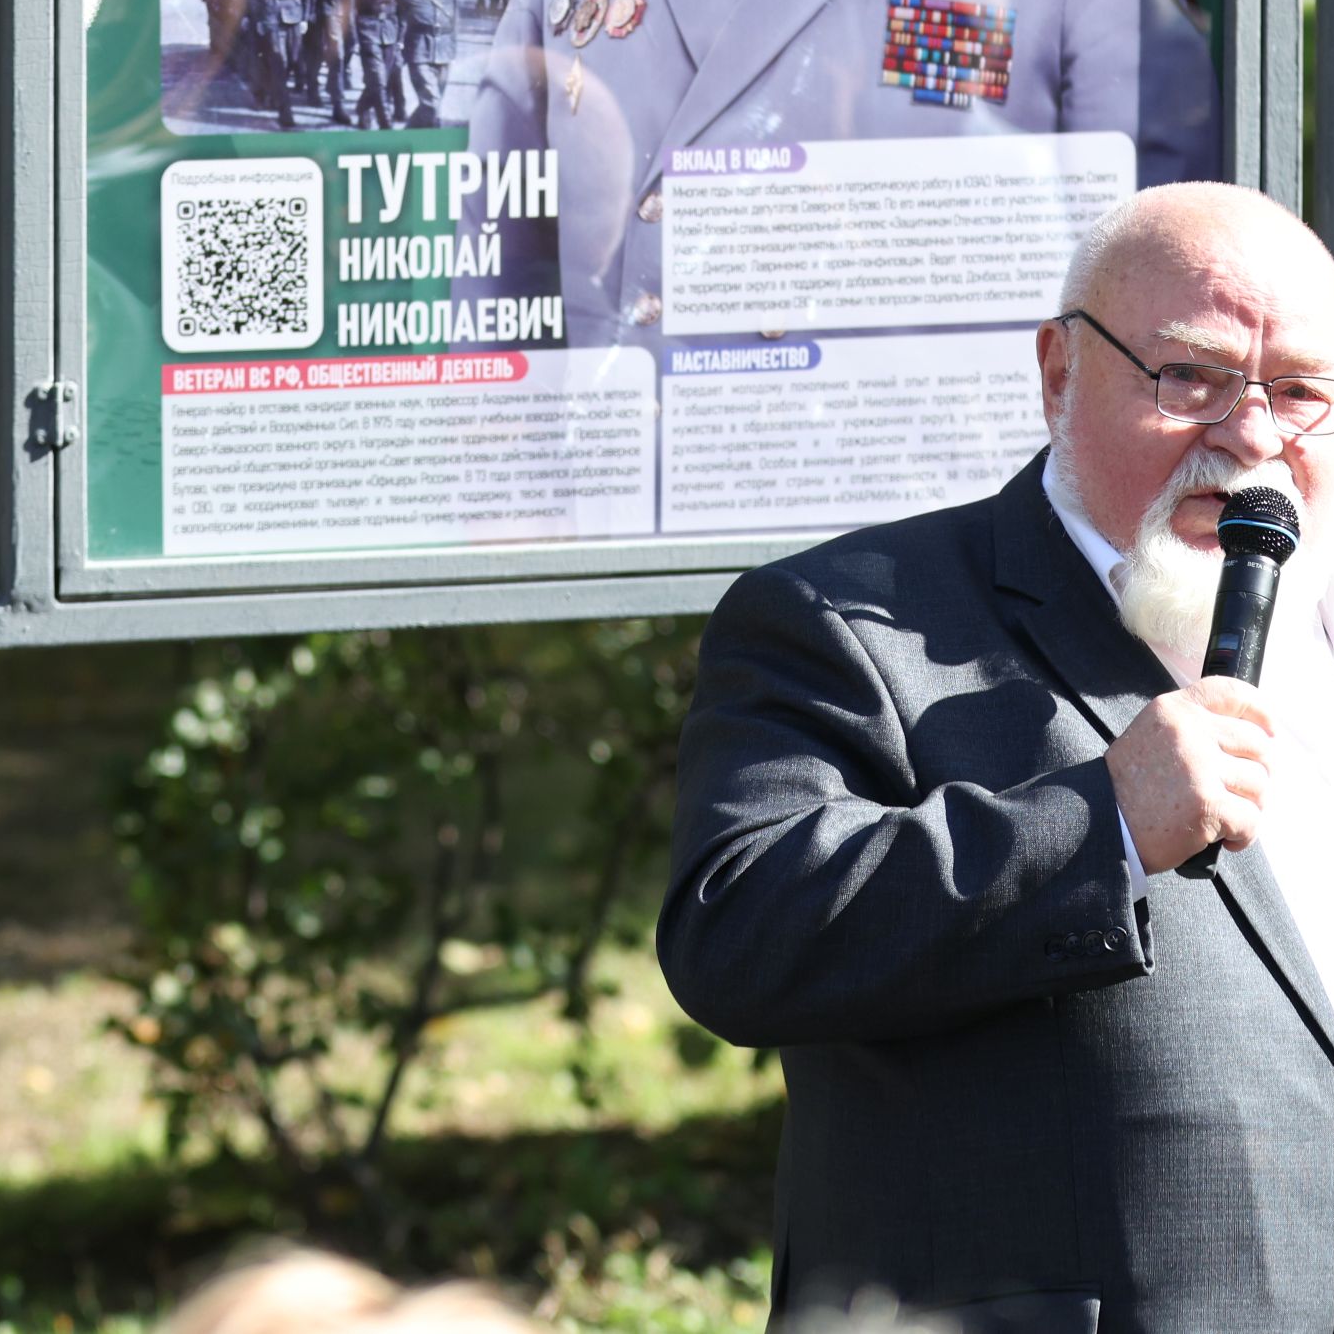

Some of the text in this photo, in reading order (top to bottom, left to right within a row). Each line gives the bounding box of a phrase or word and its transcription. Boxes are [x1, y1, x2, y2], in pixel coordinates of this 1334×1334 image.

[171, 171, 314, 186] Подробная информация
[672, 149, 726, 173] ВКЛАД
[730, 149, 741, 170] В
[338, 149, 559, 223] ТУТРИН
[339, 222, 501, 282] НИКОЛАЙ
[338, 296, 563, 347] НИКОЛАЕВИЧ
[173, 356, 514, 391] ВЕТЕРАН ВС РФ, ОБЩЕСТВЕННЫЙ ДЕЯТЕЛЬ
[672, 346, 810, 373] НАСТАВНИЧЕСТВО
